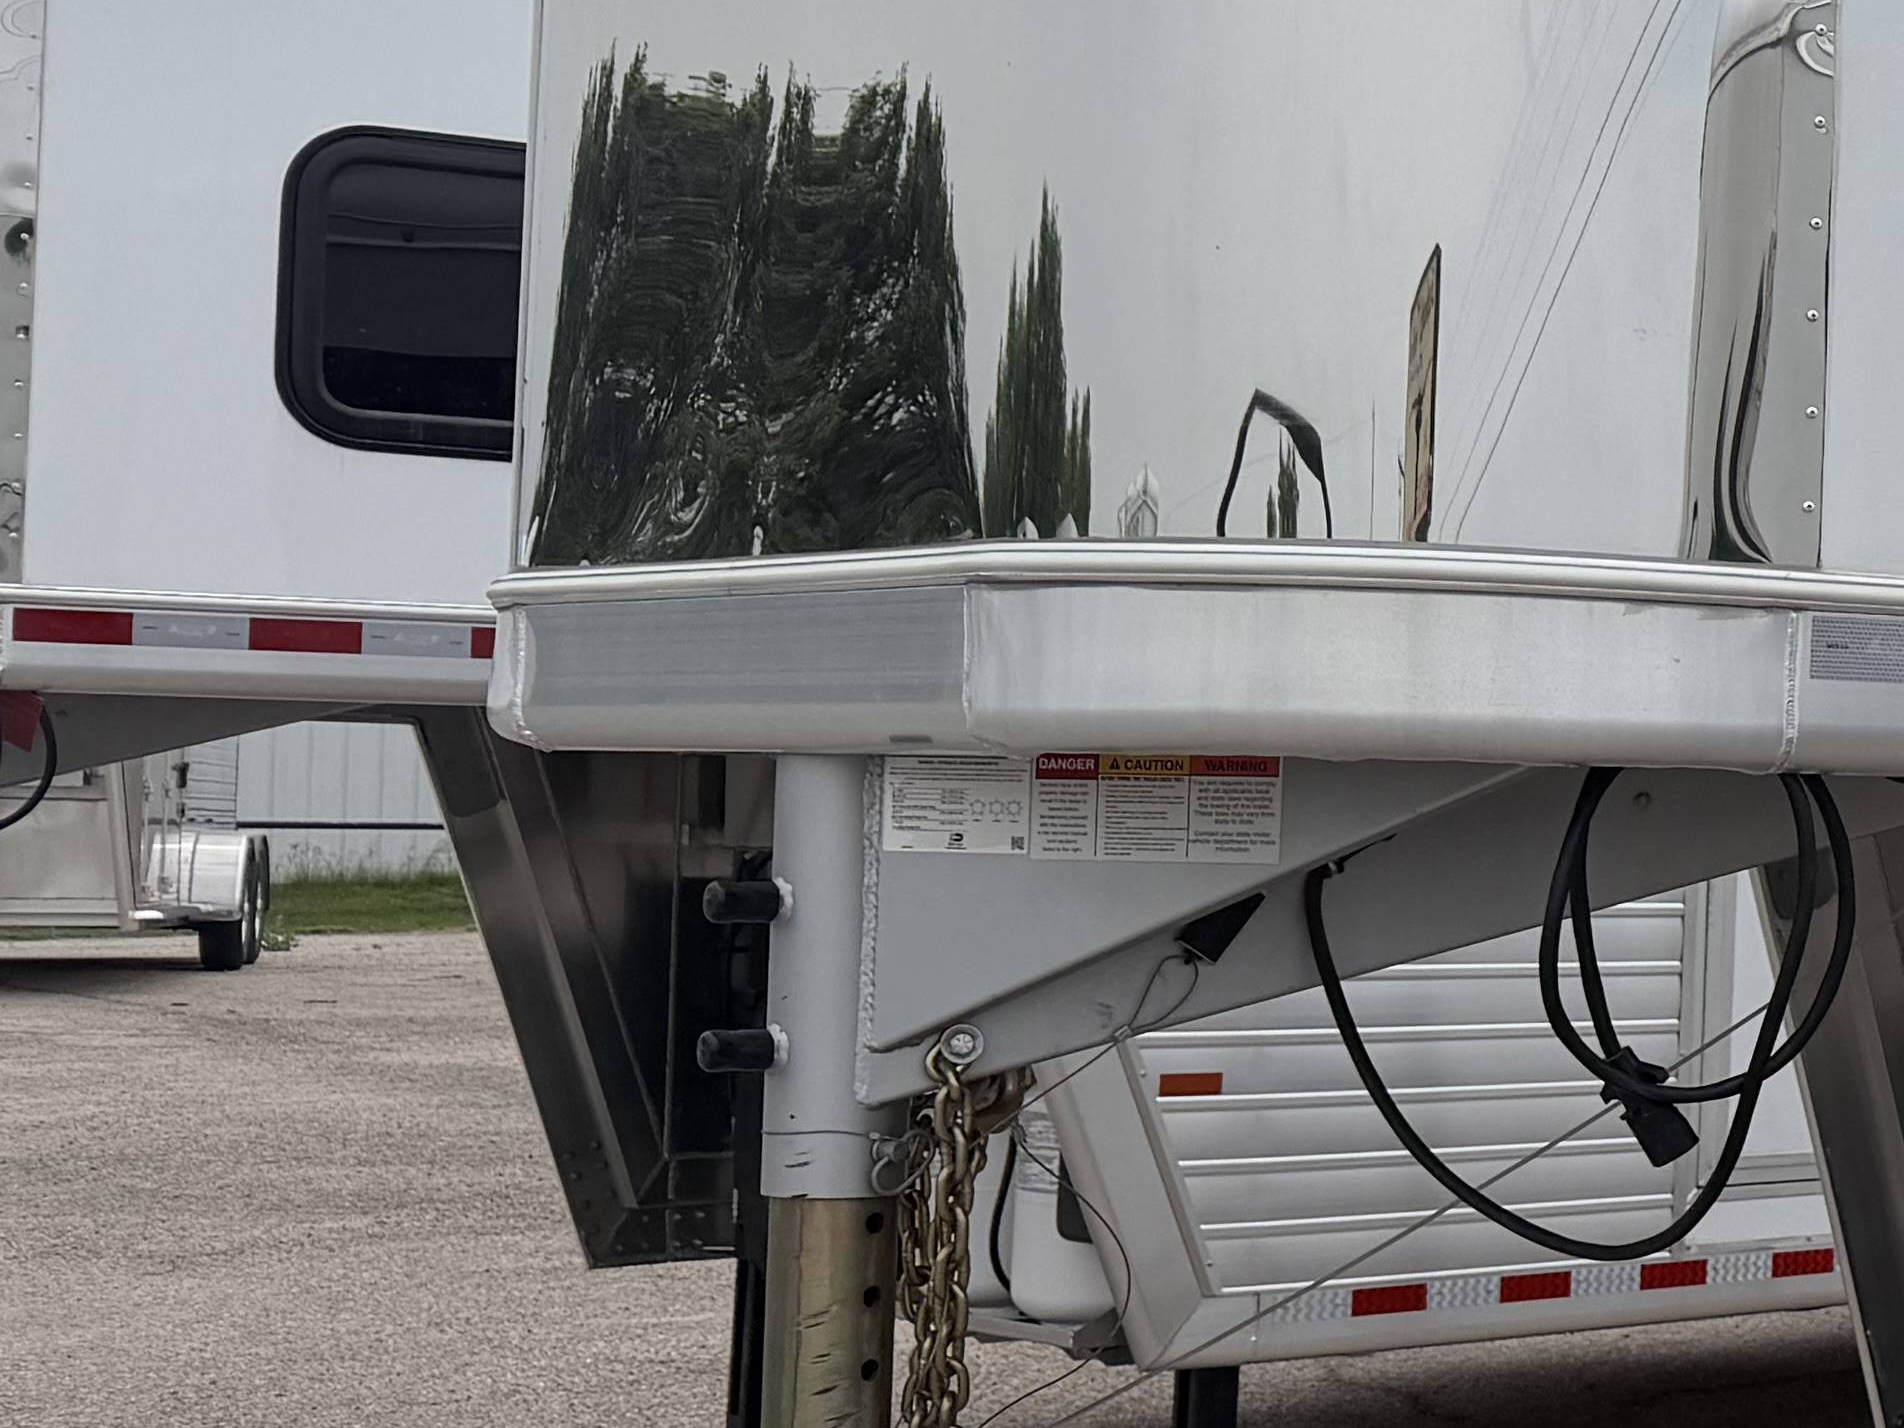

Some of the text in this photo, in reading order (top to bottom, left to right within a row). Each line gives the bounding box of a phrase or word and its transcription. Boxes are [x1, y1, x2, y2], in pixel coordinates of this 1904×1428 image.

[1038, 757, 1095, 771] DANGER
[1124, 759, 1184, 772] CAUTION
[1204, 759, 1268, 773] WARNING
